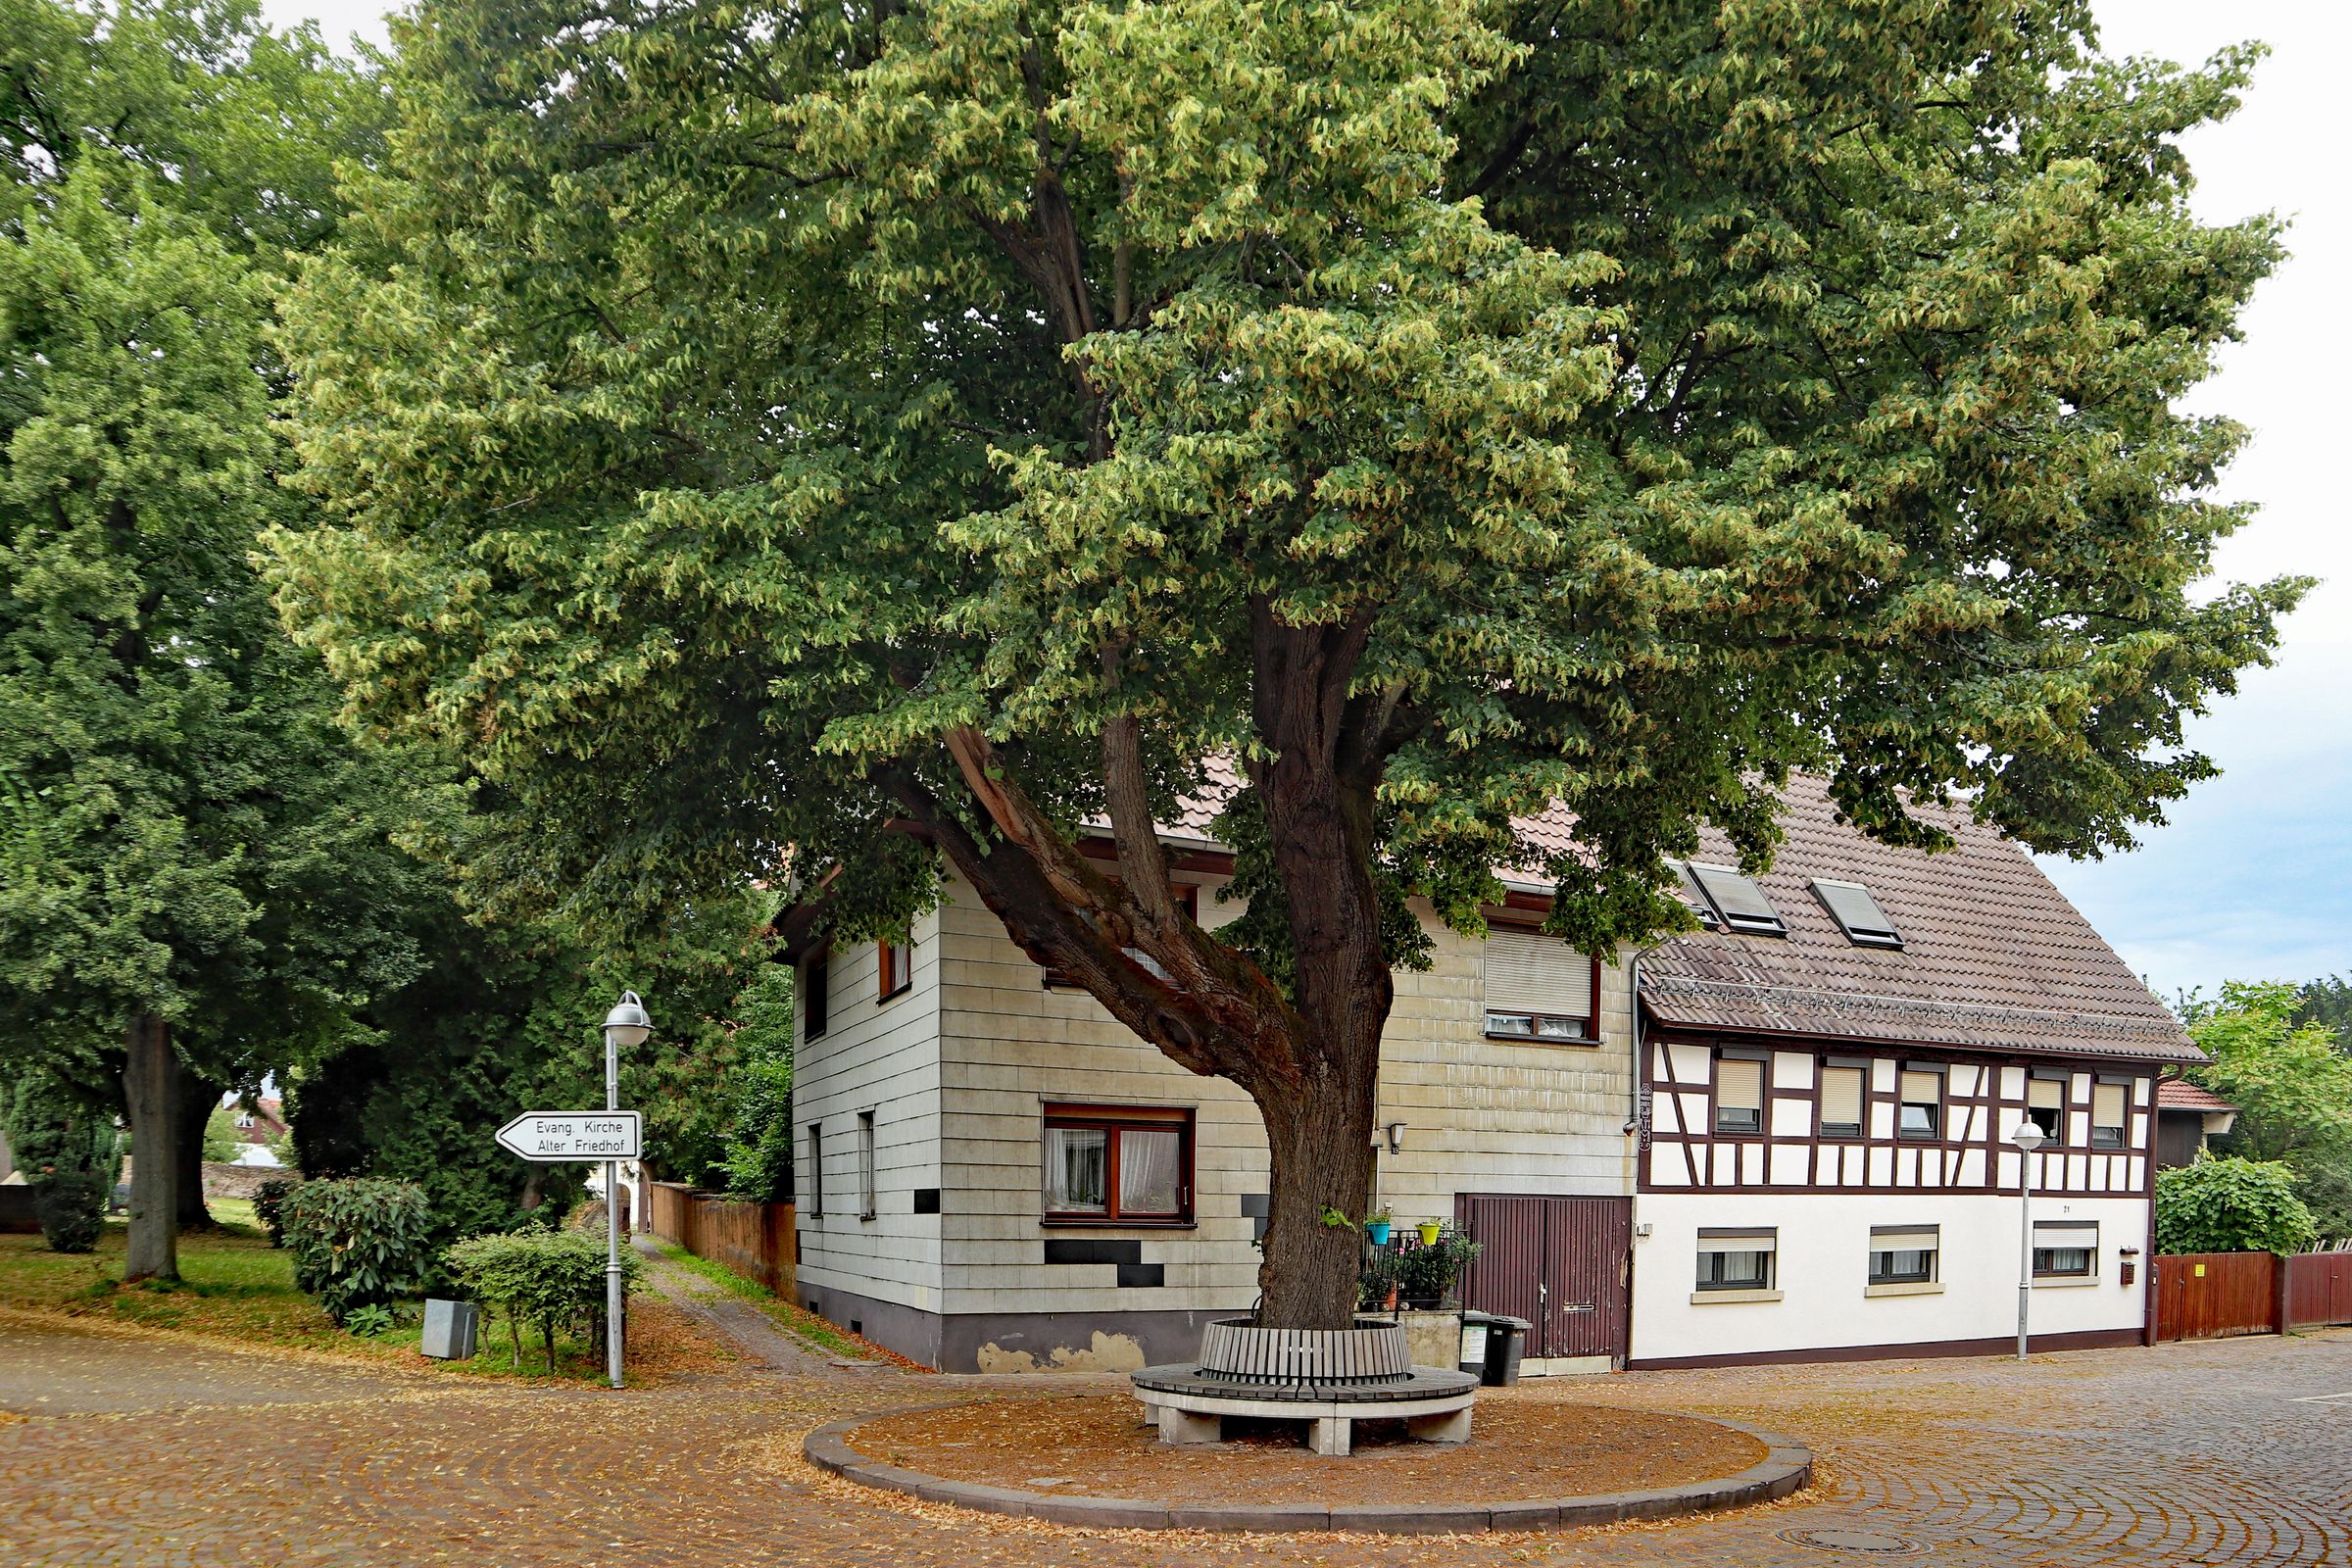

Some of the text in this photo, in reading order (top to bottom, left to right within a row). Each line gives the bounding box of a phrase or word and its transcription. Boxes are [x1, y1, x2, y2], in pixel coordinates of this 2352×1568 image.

[536, 1121, 623, 1136] Evang. Kirche
[537, 1139, 625, 1152] Alter Friedhof
